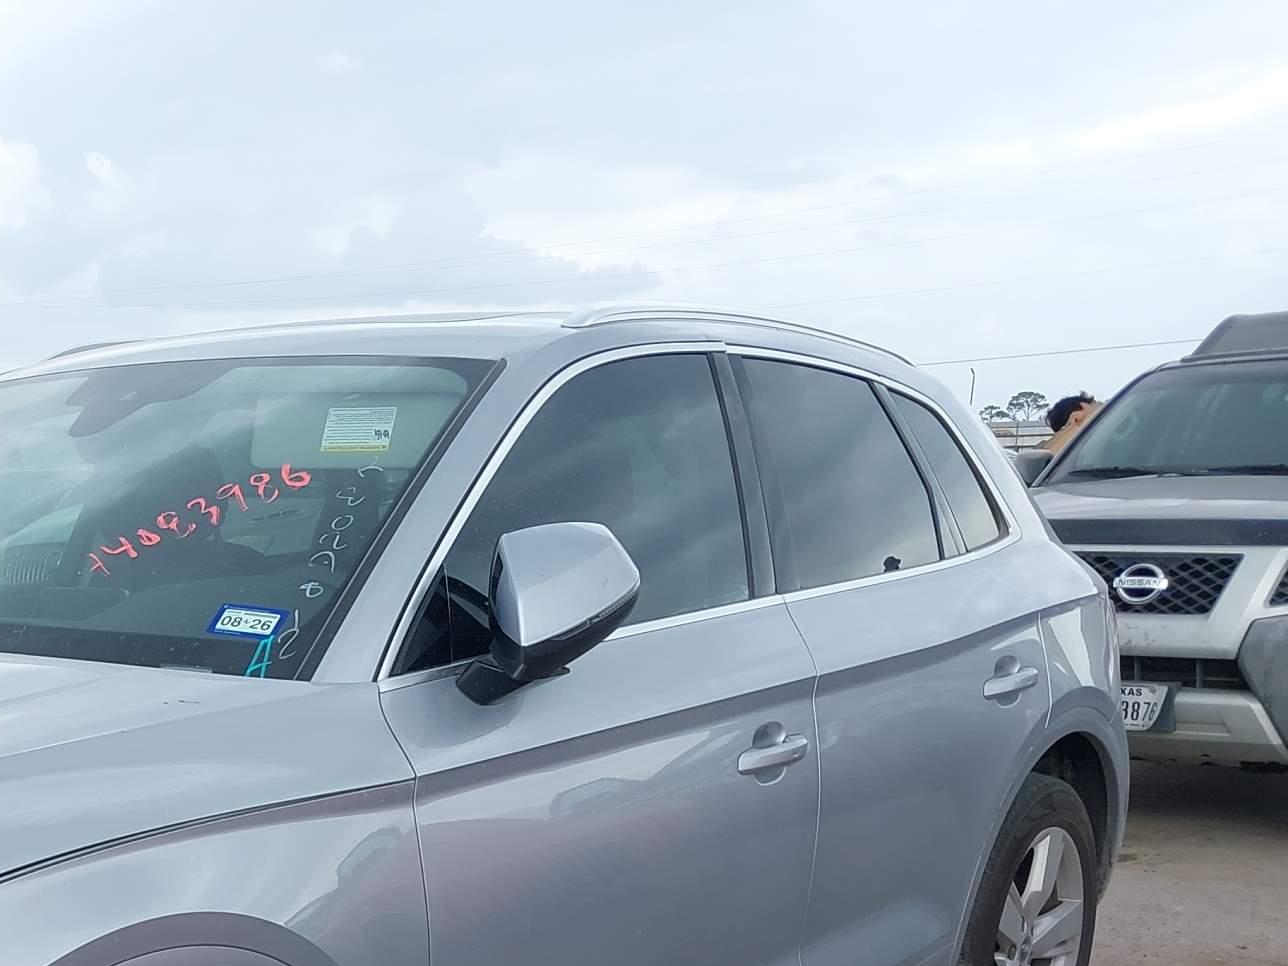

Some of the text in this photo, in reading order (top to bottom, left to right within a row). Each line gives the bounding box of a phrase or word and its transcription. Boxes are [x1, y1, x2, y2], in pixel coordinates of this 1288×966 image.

[220, 615, 273, 631] 08 26
[1120, 687, 1143, 697] XAS
